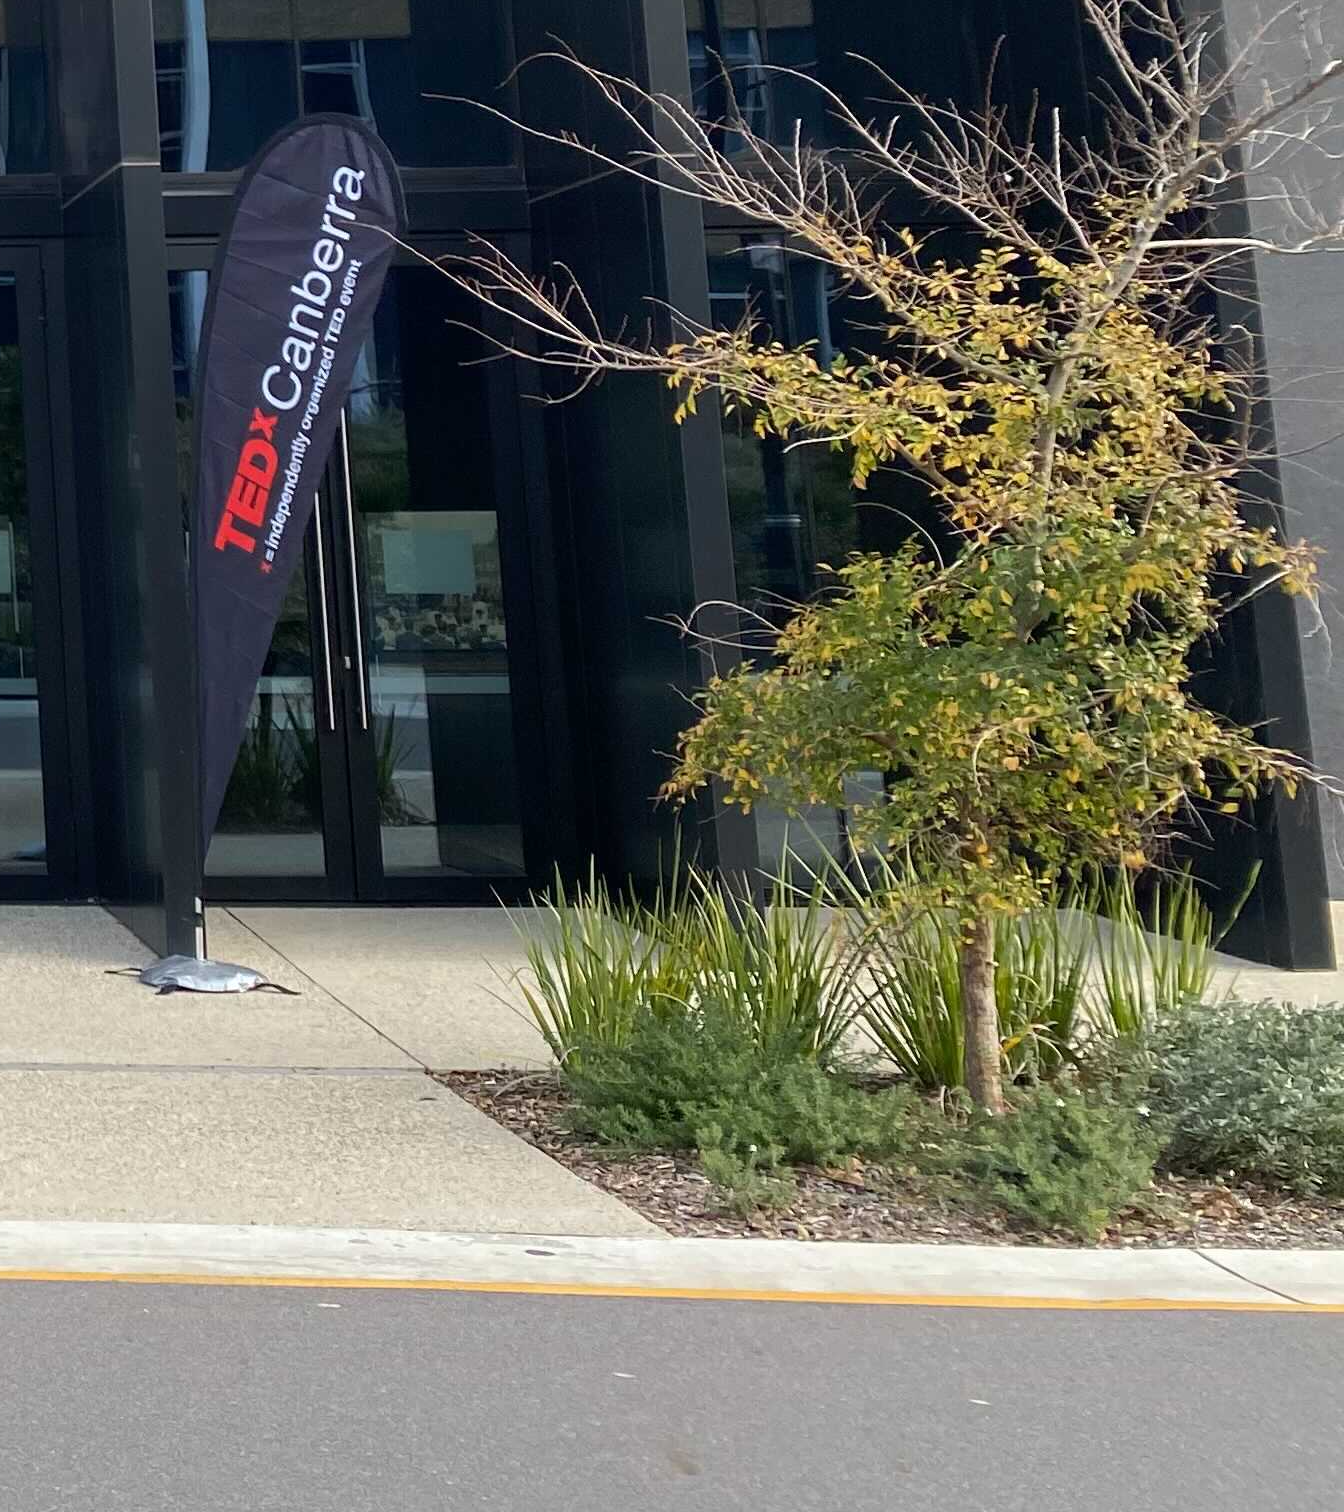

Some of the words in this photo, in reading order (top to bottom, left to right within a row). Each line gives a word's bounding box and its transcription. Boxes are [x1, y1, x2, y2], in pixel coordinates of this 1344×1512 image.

[301, 345, 337, 430] organized
[324, 306, 346, 345] TED
[339, 258, 364, 306] event
